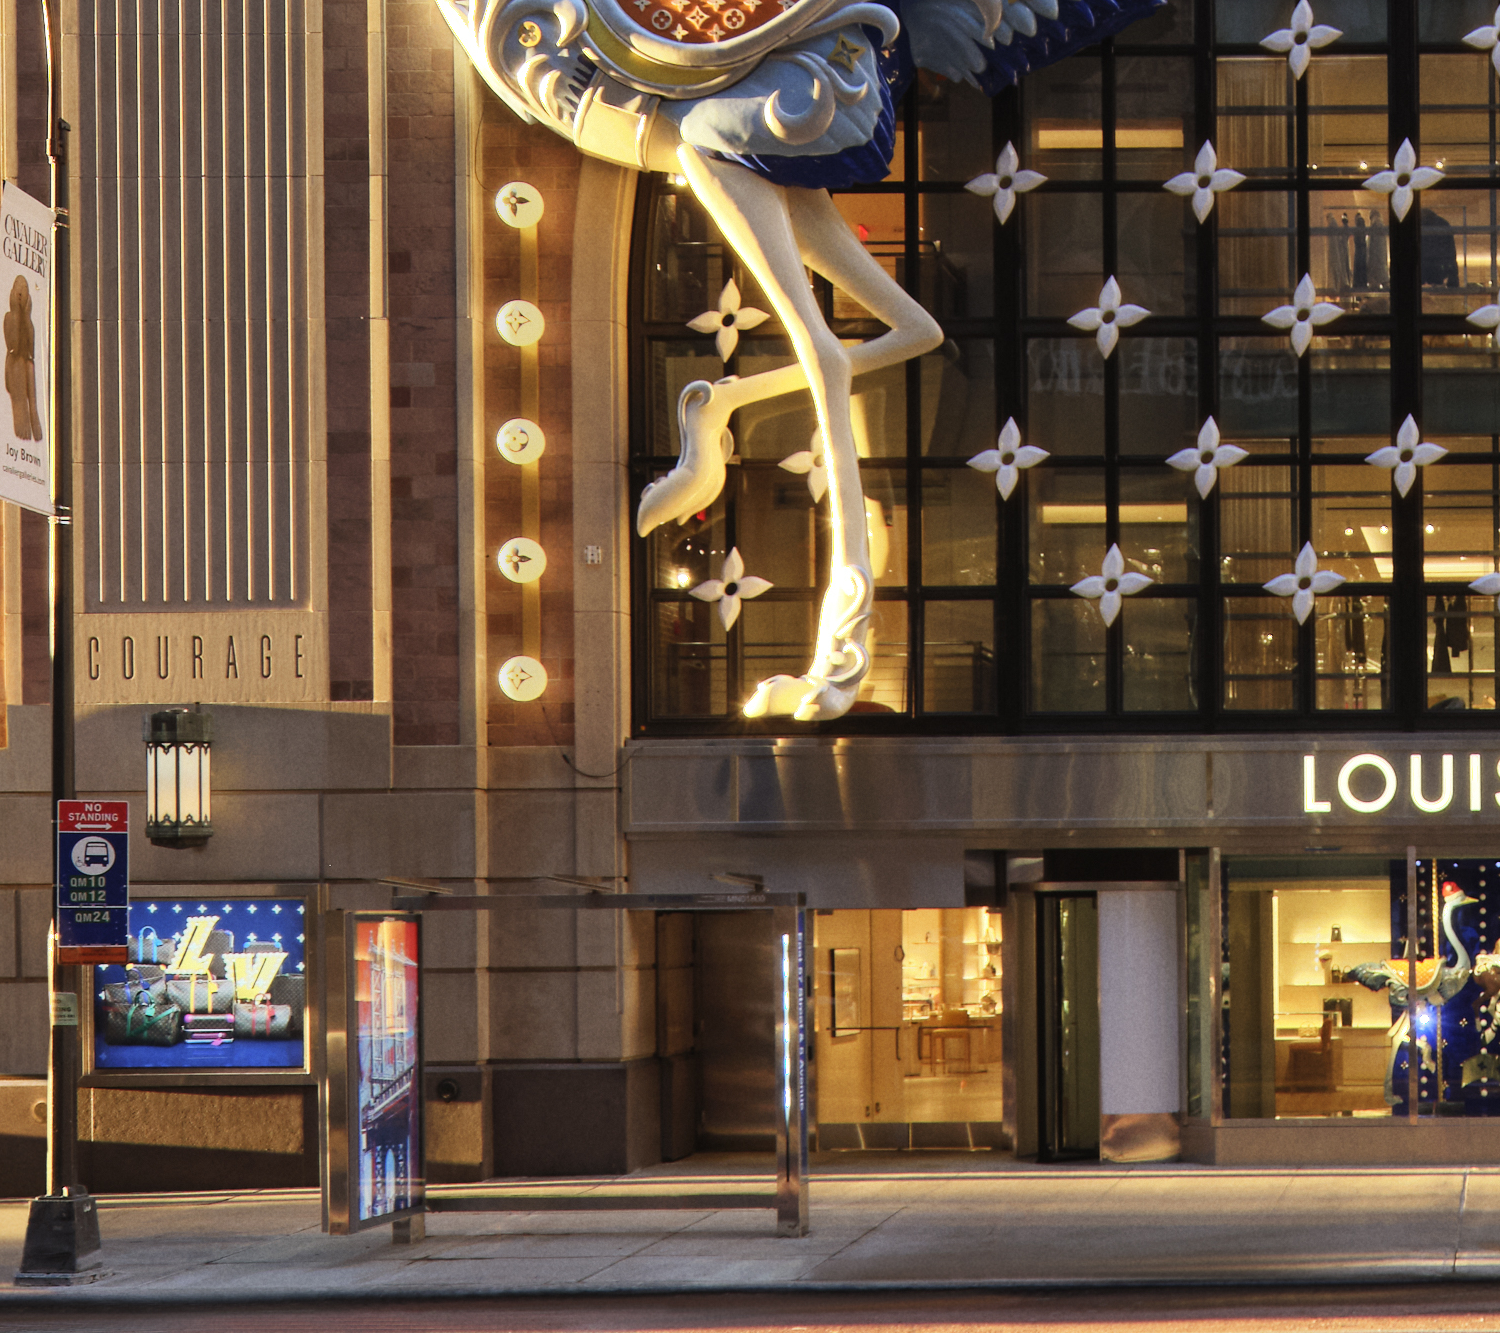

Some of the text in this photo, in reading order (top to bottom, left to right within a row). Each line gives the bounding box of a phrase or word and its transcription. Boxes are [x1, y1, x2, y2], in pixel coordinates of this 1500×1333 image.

[4, 214, 47, 257] CAVALIER
[3, 236, 47, 278] GALLERY
[5, 443, 41, 467] Joy Brown
[88, 633, 306, 681] COURAGE
[85, 804, 102, 812] NO
[68, 813, 119, 822] STANDING
[70, 876, 106, 888] QM10
[70, 890, 106, 902] QM12
[75, 911, 111, 922] QM24
